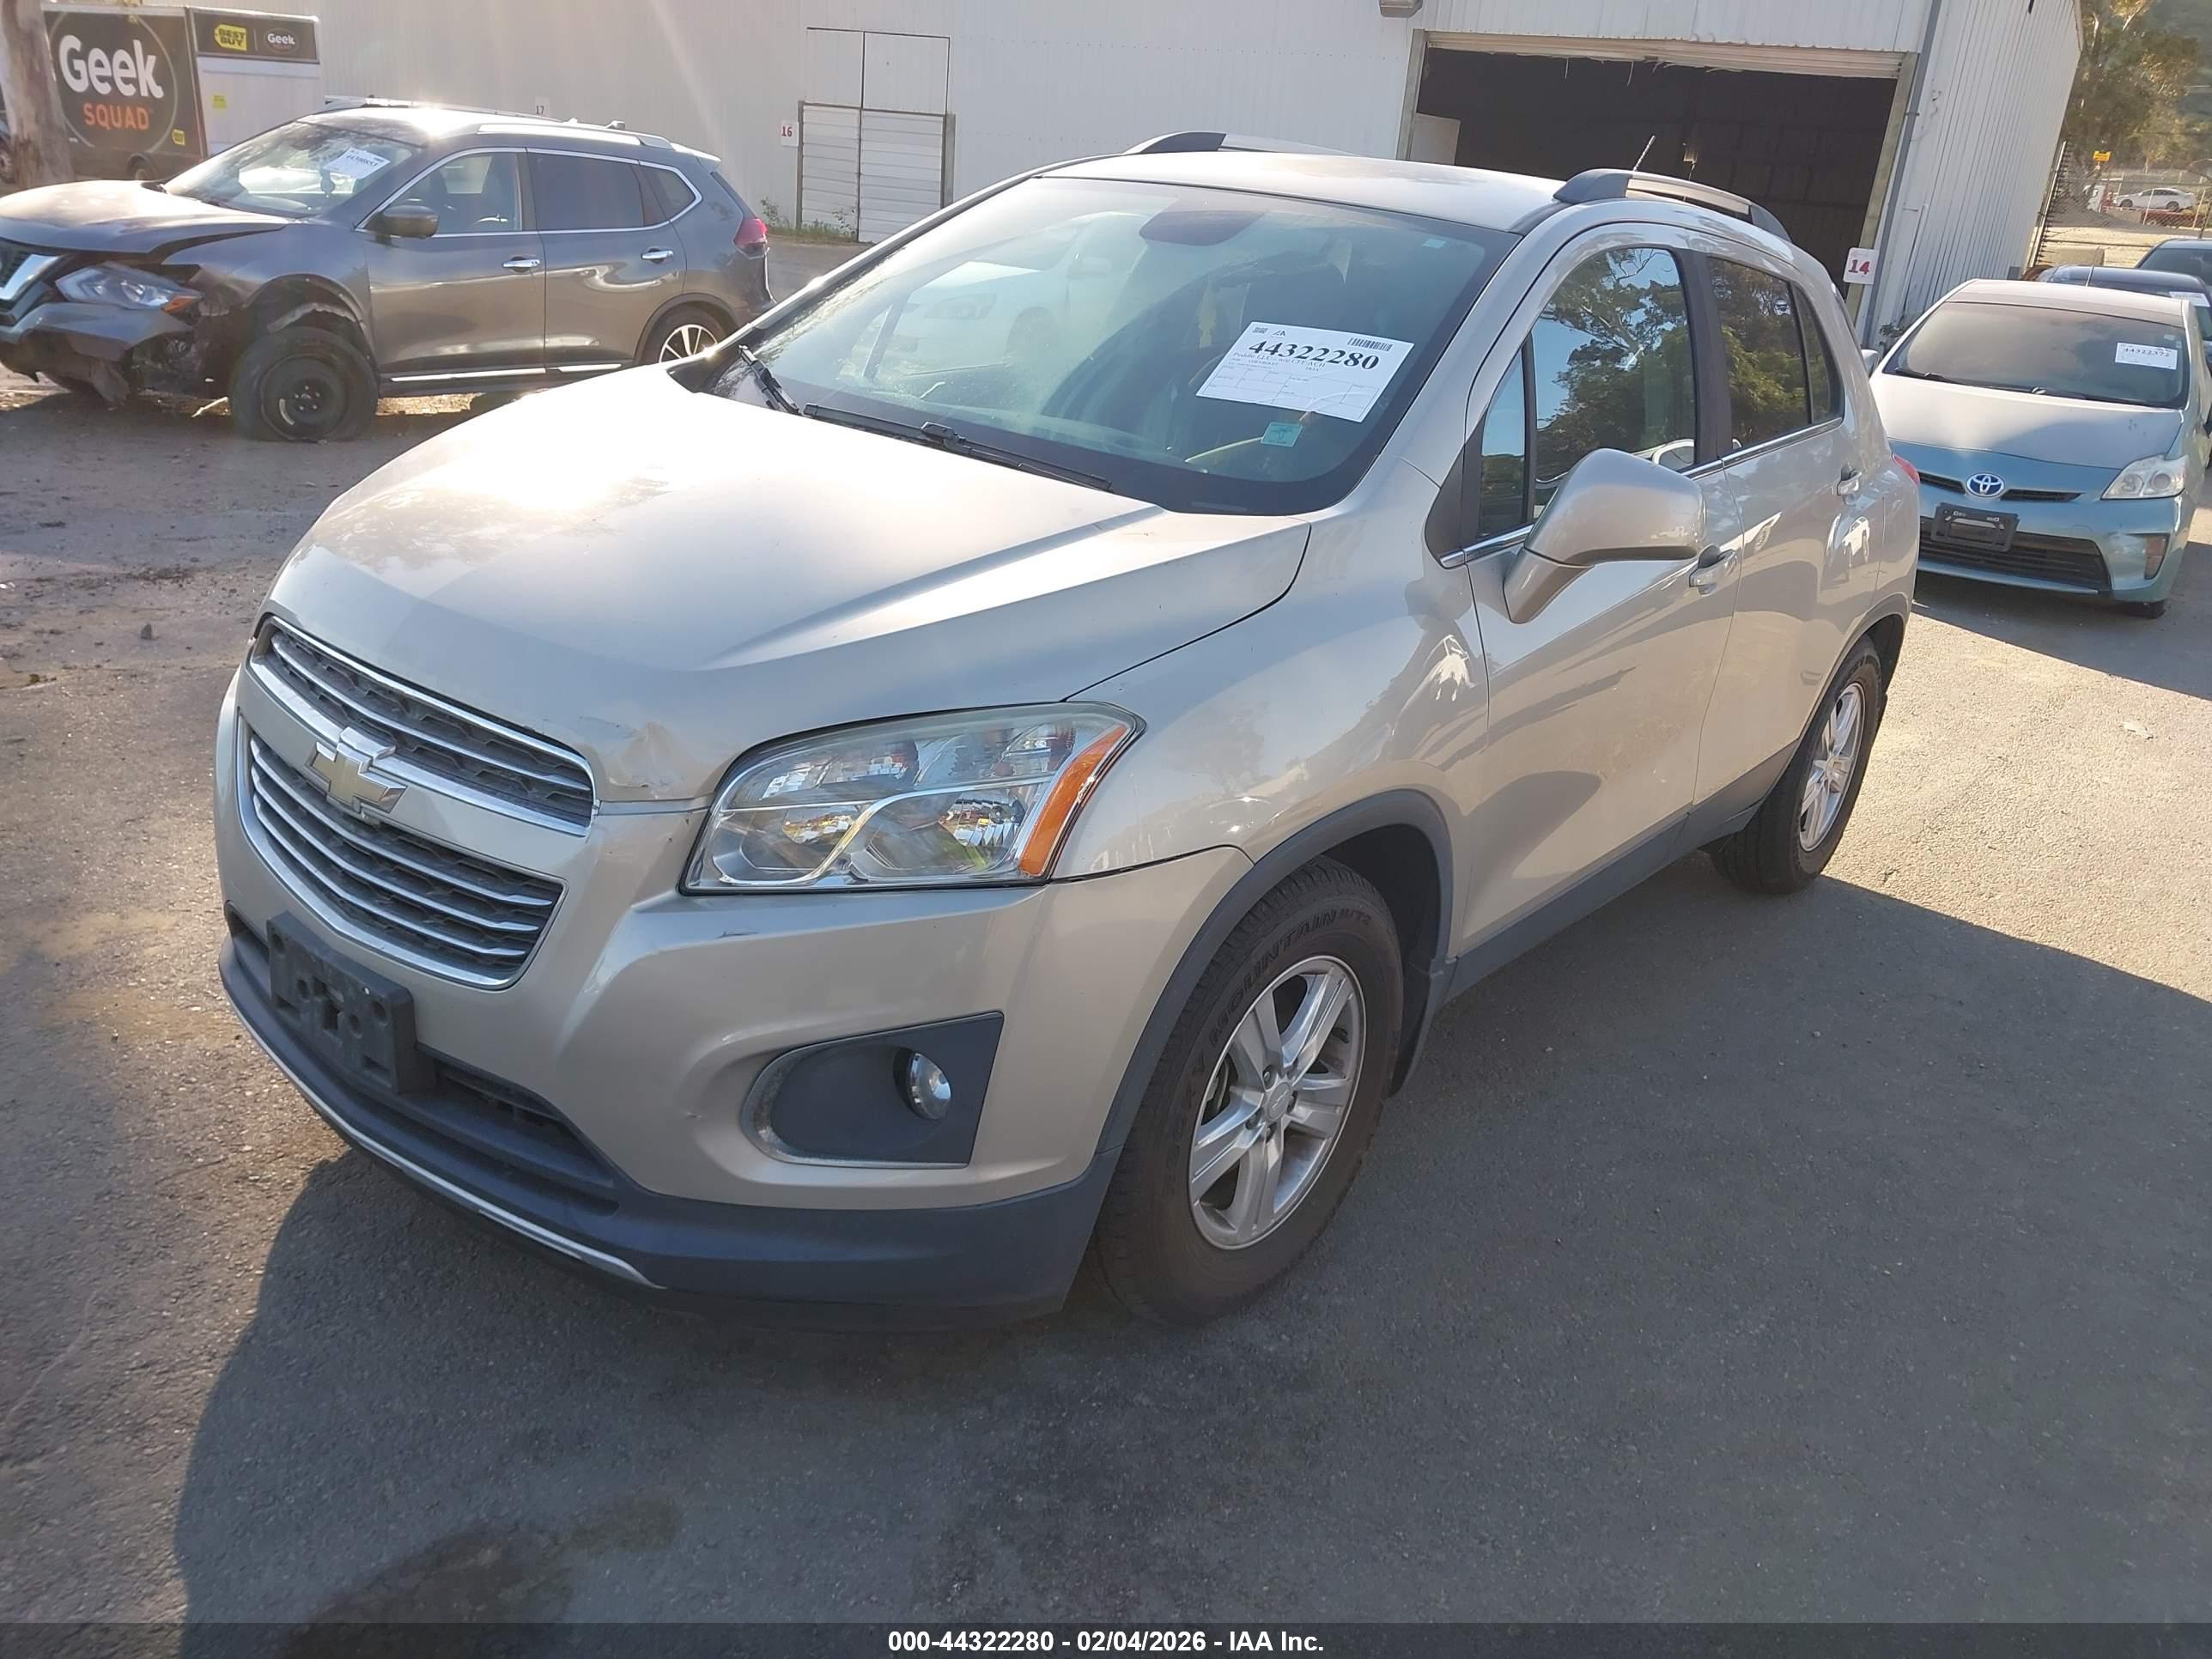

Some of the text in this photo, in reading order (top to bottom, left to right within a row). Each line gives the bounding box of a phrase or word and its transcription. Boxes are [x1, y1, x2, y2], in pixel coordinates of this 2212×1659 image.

[218, 27, 246, 40] BEST
[267, 33, 296, 45] Geek
[221, 36, 244, 46] BUY
[59, 34, 164, 99] Geek
[82, 103, 149, 130] SQUAD
[536, 105, 544, 115] 17
[781, 125, 793, 137] 16
[1848, 259, 1870, 275] 14
[1249, 340, 1380, 370] 44322280
[1207, 908, 1338, 1047] MOUNTAIN
